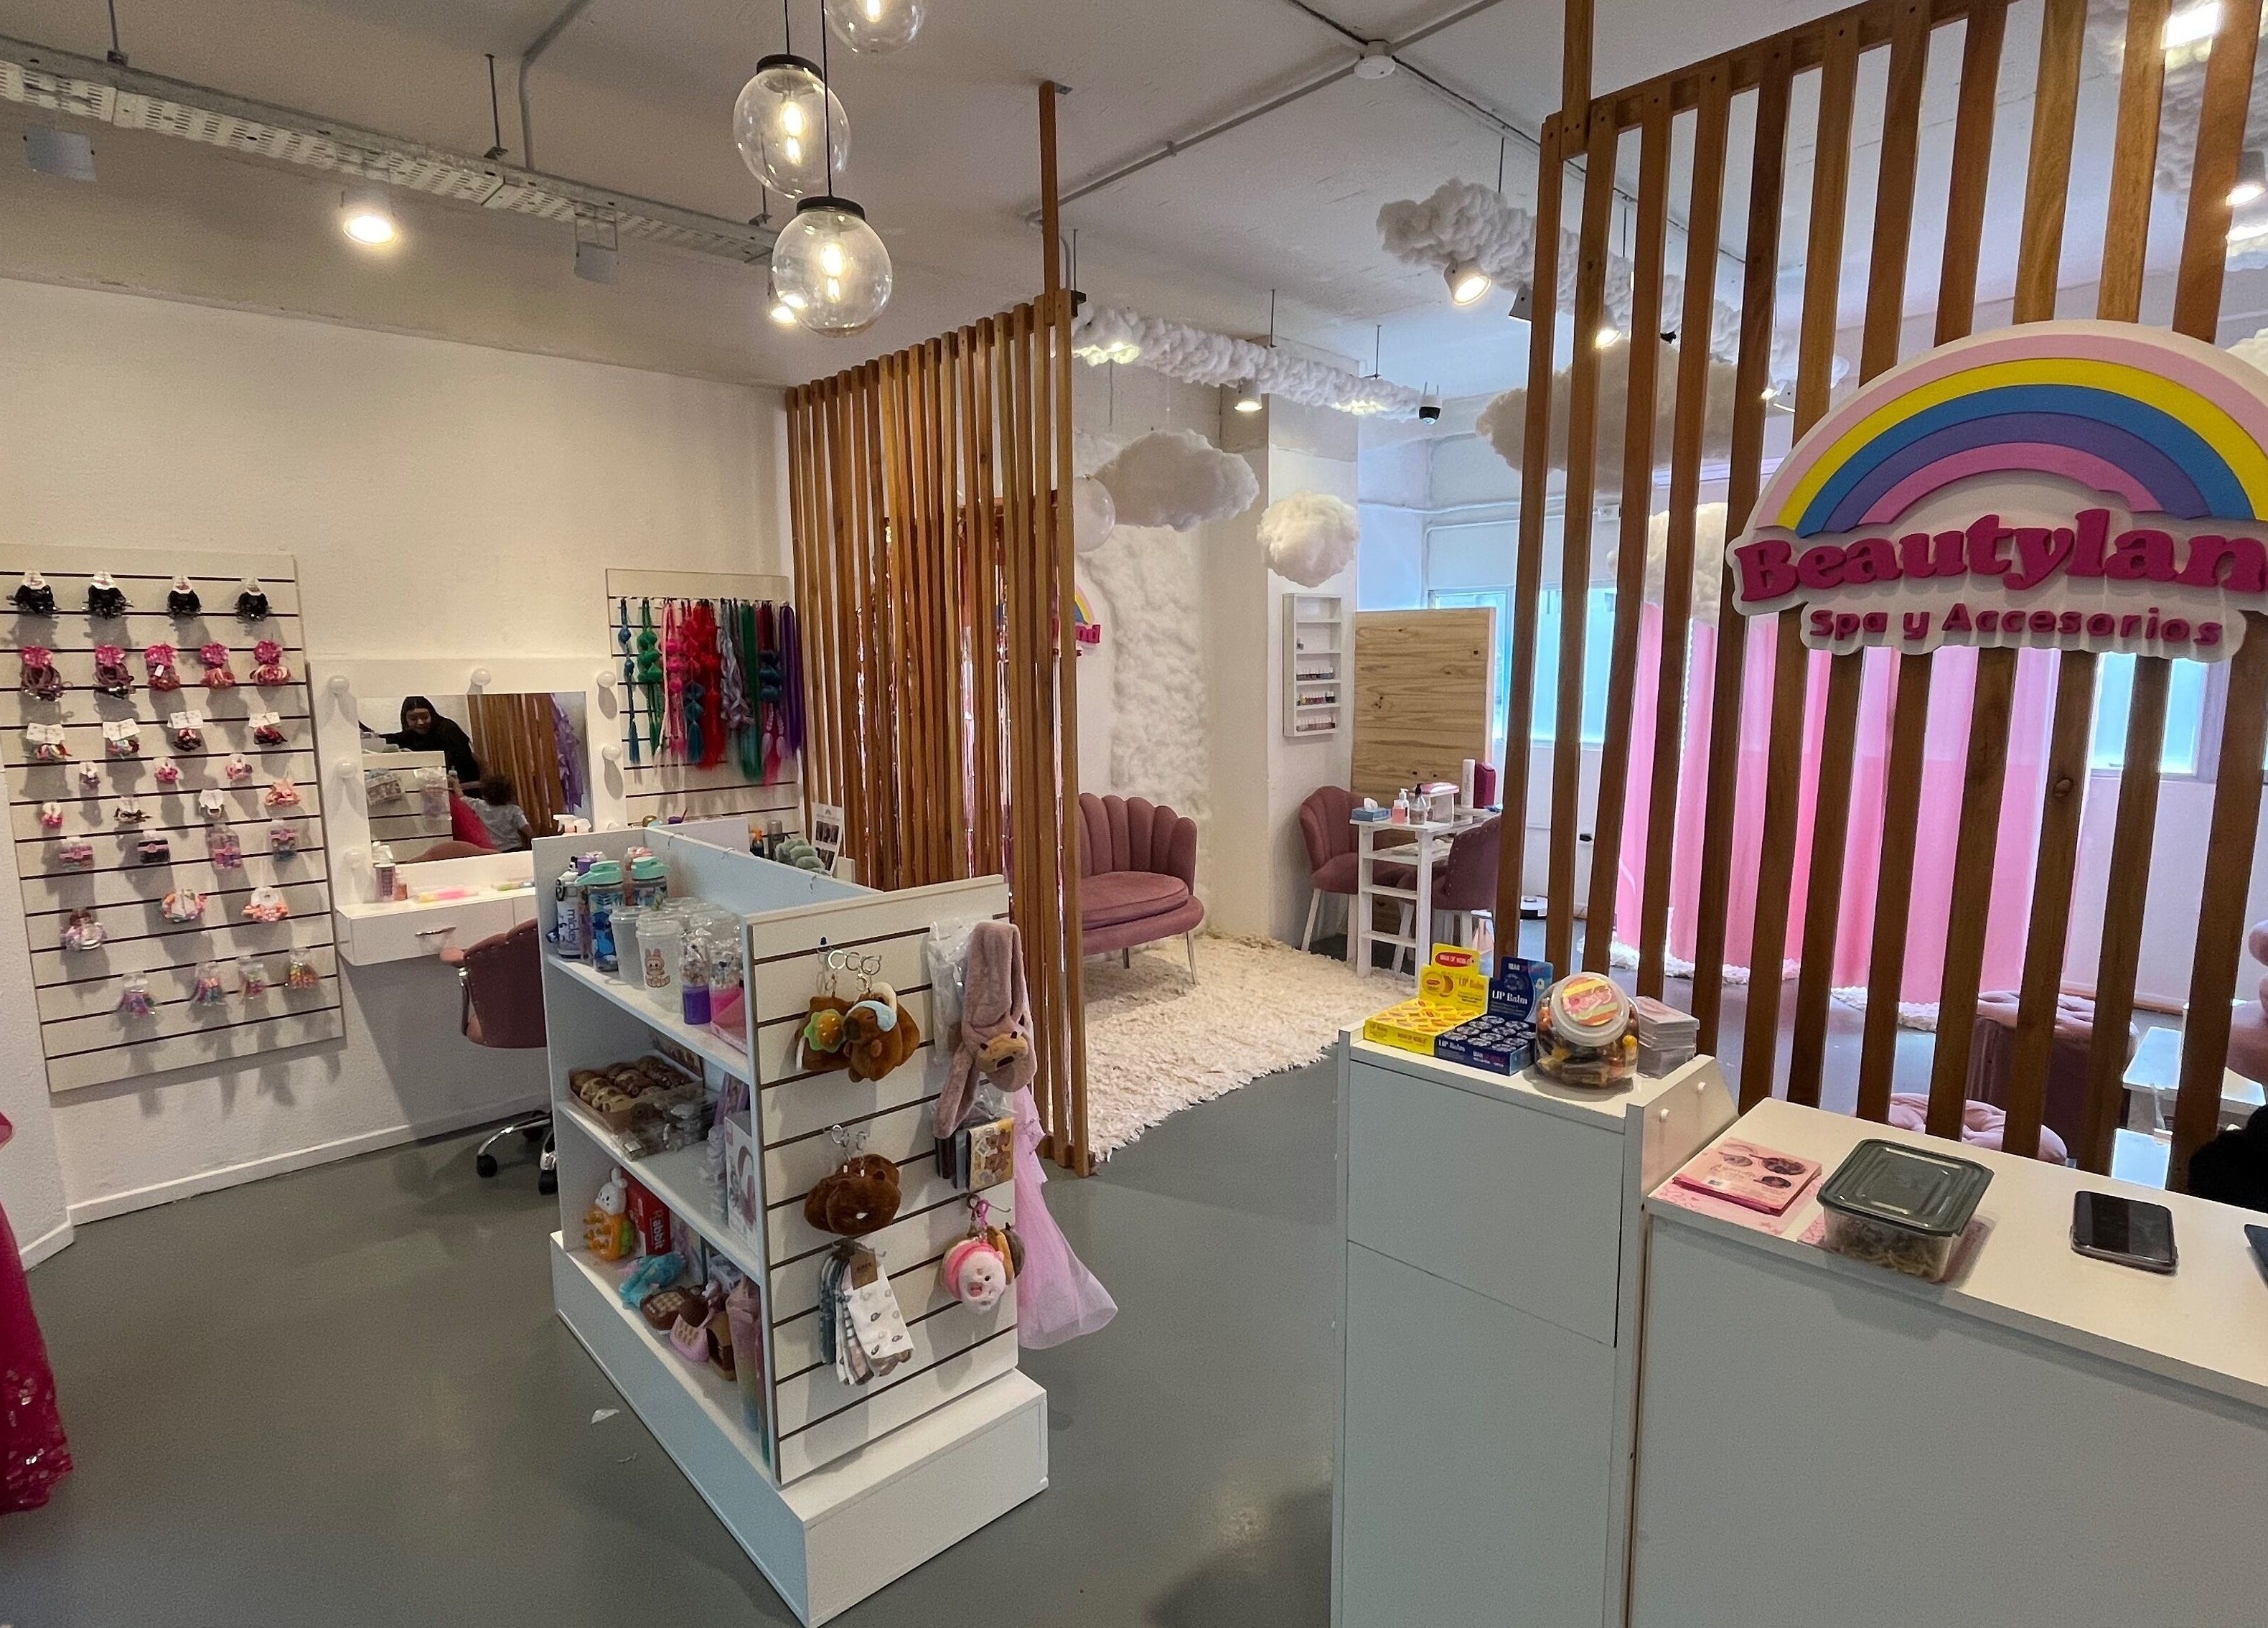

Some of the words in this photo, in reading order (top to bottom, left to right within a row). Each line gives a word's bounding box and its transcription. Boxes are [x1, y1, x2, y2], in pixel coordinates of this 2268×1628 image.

[1734, 508, 2268, 603] Beautylan
[1809, 609, 1888, 641] Spa
[1903, 612, 1931, 640] y
[1941, 603, 2224, 646] Accesorios
[1506, 992, 1528, 1005] Balm
[652, 1210, 665, 1250] Rabbit
